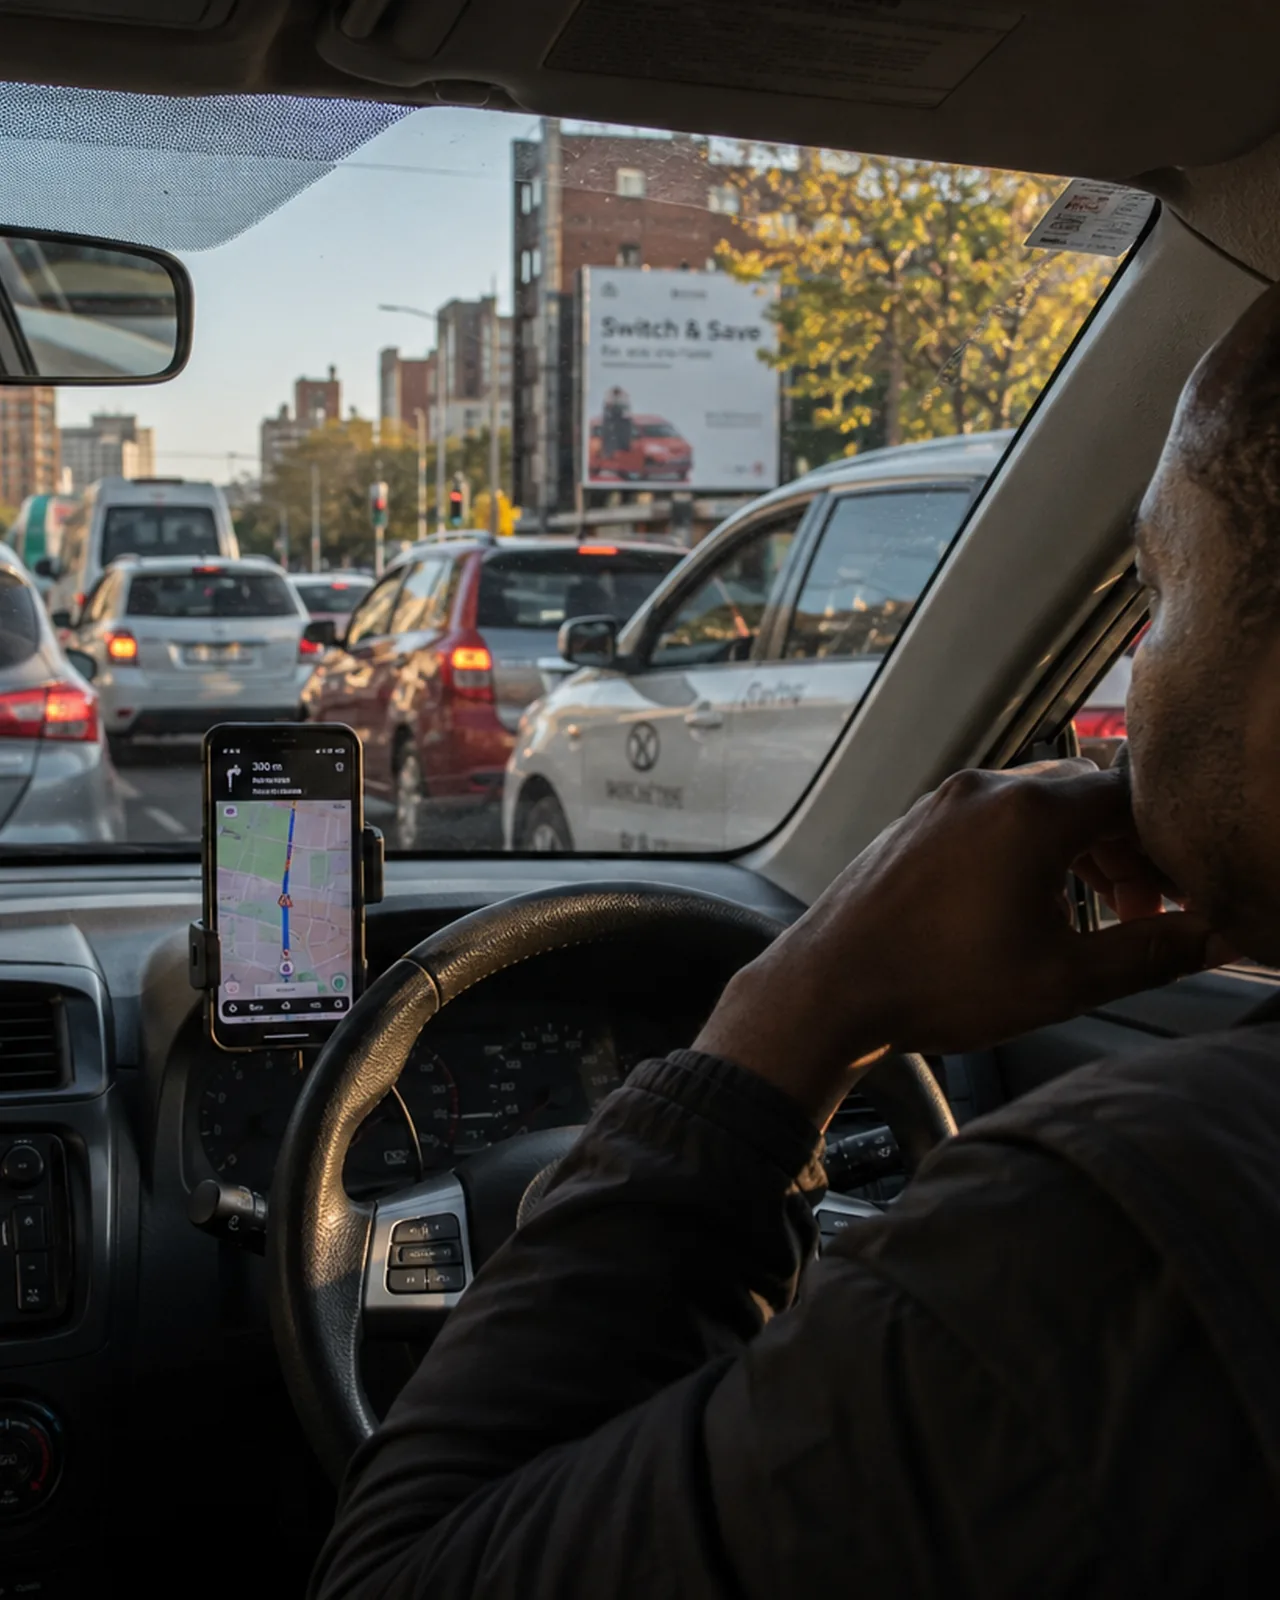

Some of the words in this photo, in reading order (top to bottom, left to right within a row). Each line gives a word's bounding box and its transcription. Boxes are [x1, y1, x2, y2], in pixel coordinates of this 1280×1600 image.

[601, 316, 679, 339] Switch
[685, 318, 701, 340] &
[707, 319, 762, 341] Save
[252, 761, 271, 772] 300
